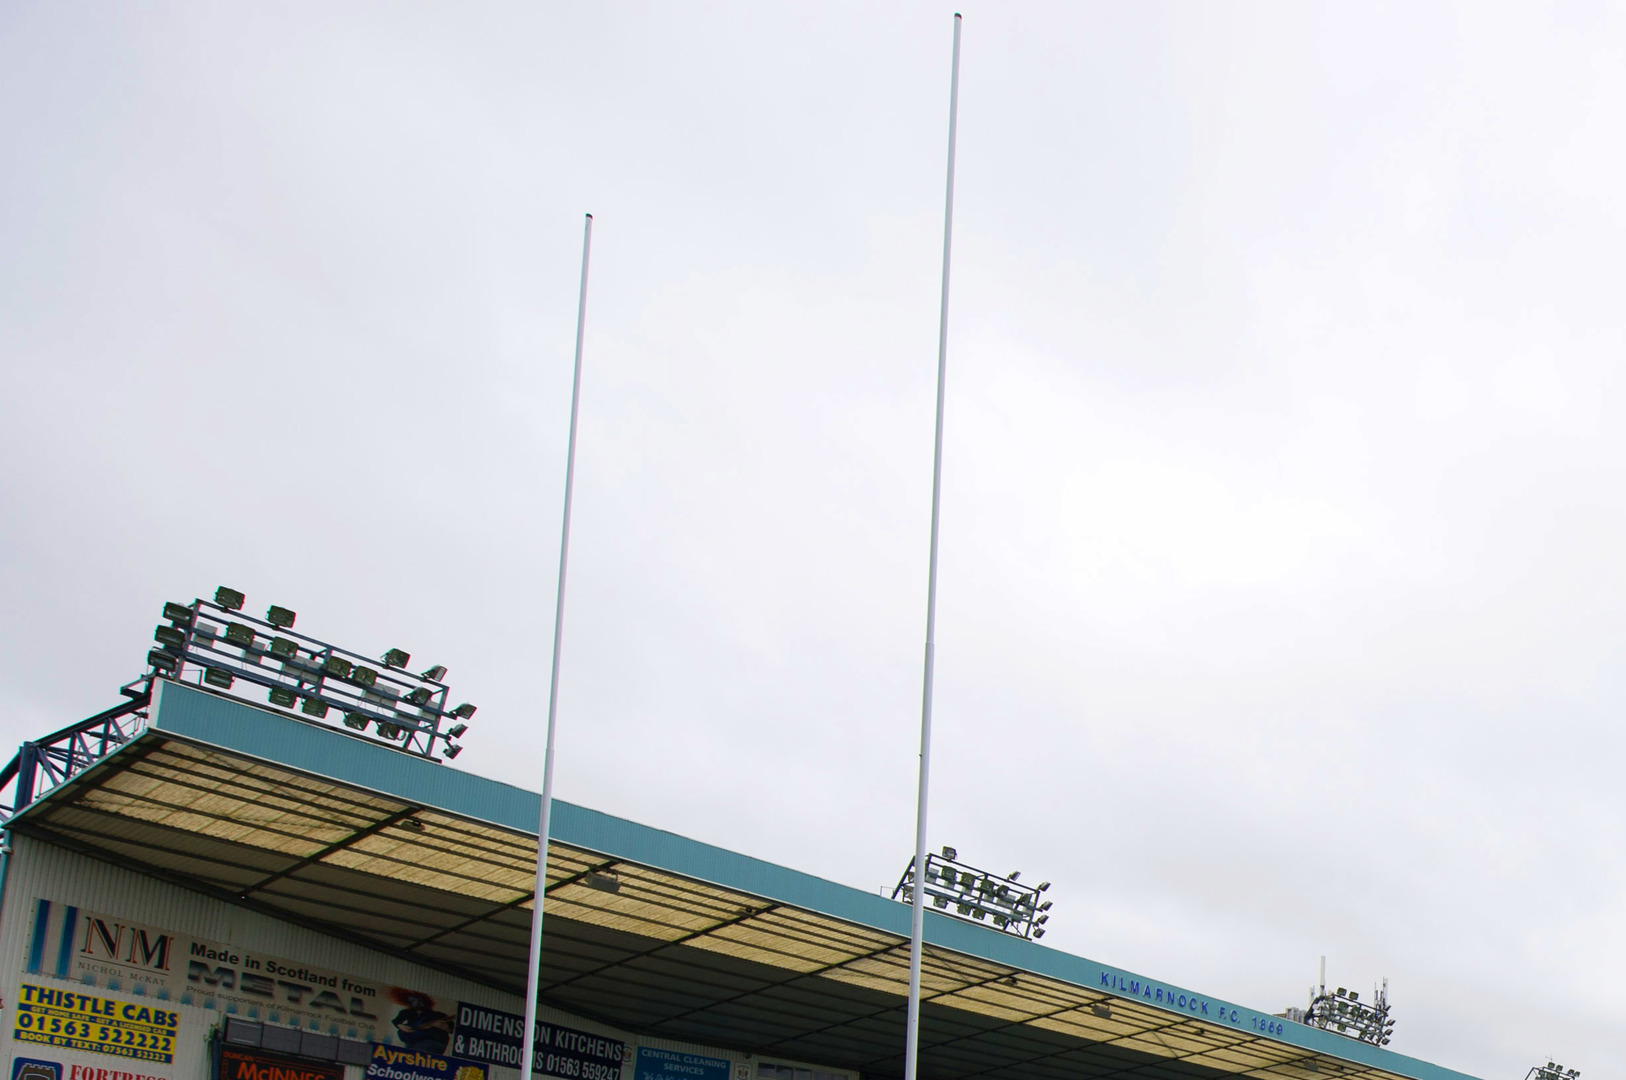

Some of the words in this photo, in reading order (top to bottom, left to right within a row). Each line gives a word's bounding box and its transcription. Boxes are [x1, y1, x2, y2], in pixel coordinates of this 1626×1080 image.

[80, 915, 174, 972] NM
[78, 961, 124, 978] NICHOL
[190, 942, 240, 965] Made
[245, 955, 260, 970] in
[266, 960, 338, 988] Scotland
[342, 978, 376, 998] from
[22, 984, 116, 1016] THISTLE
[122, 1004, 178, 1028] CABS
[186, 985, 214, 998] Proud
[218, 992, 264, 1008] supporters
[188, 960, 378, 1020] METAL
[1100, 971, 1208, 1015] KILMARNOCK
[1218, 1006, 1240, 1024] F.C.
[1252, 1016, 1283, 1035] 1869
[31, 1006, 46, 1014] GET
[49, 1008, 70, 1018] HOME
[18, 1014, 90, 1038] 01563
[98, 1027, 172, 1052] 522222
[20, 1031, 52, 1042] BOOK
[53, 1034, 67, 1046] BY
[72, 1038, 101, 1050] TEXT:
[459, 1006, 552, 1046] DIMENSON
[555, 1030, 624, 1062] KITCHENS
[372, 1044, 448, 1072] Ayrshire
[454, 1034, 466, 1054] &
[468, 1037, 544, 1070] BATHROOS
[546, 1055, 580, 1077] 01563
[641, 1049, 680, 1062] CENTRAL
[683, 1056, 728, 1069] CLEANING
[664, 1062, 704, 1076] SERVICES
